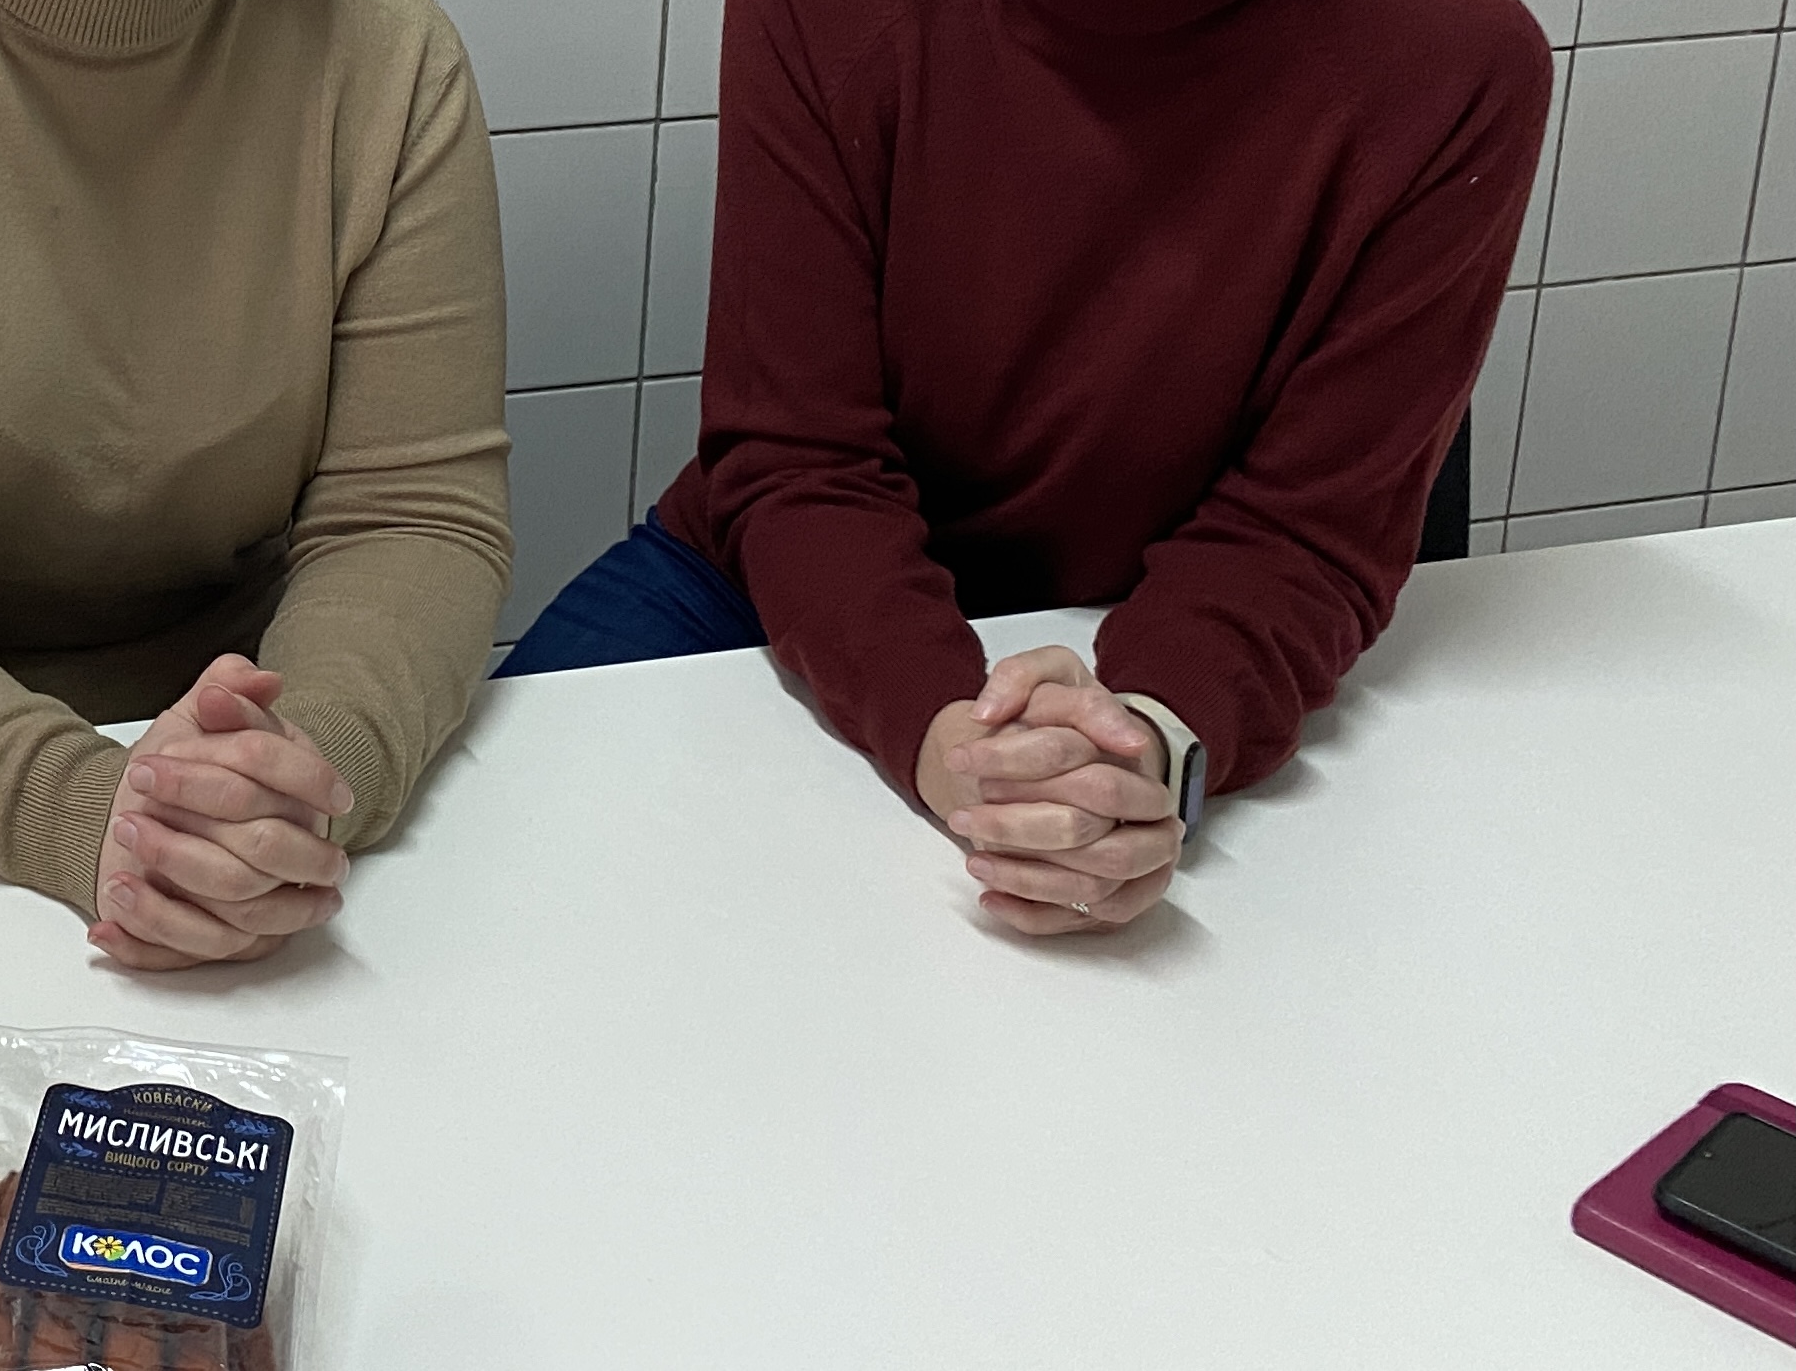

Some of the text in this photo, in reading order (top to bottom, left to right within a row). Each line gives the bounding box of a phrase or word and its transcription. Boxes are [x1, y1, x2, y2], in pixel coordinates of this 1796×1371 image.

[132, 1091, 213, 1113] КОВБАСКИ
[57, 1108, 269, 1172] МИСЛИВСЬКІ
[104, 1150, 209, 1177] ВИЩОГО СОРТУ
